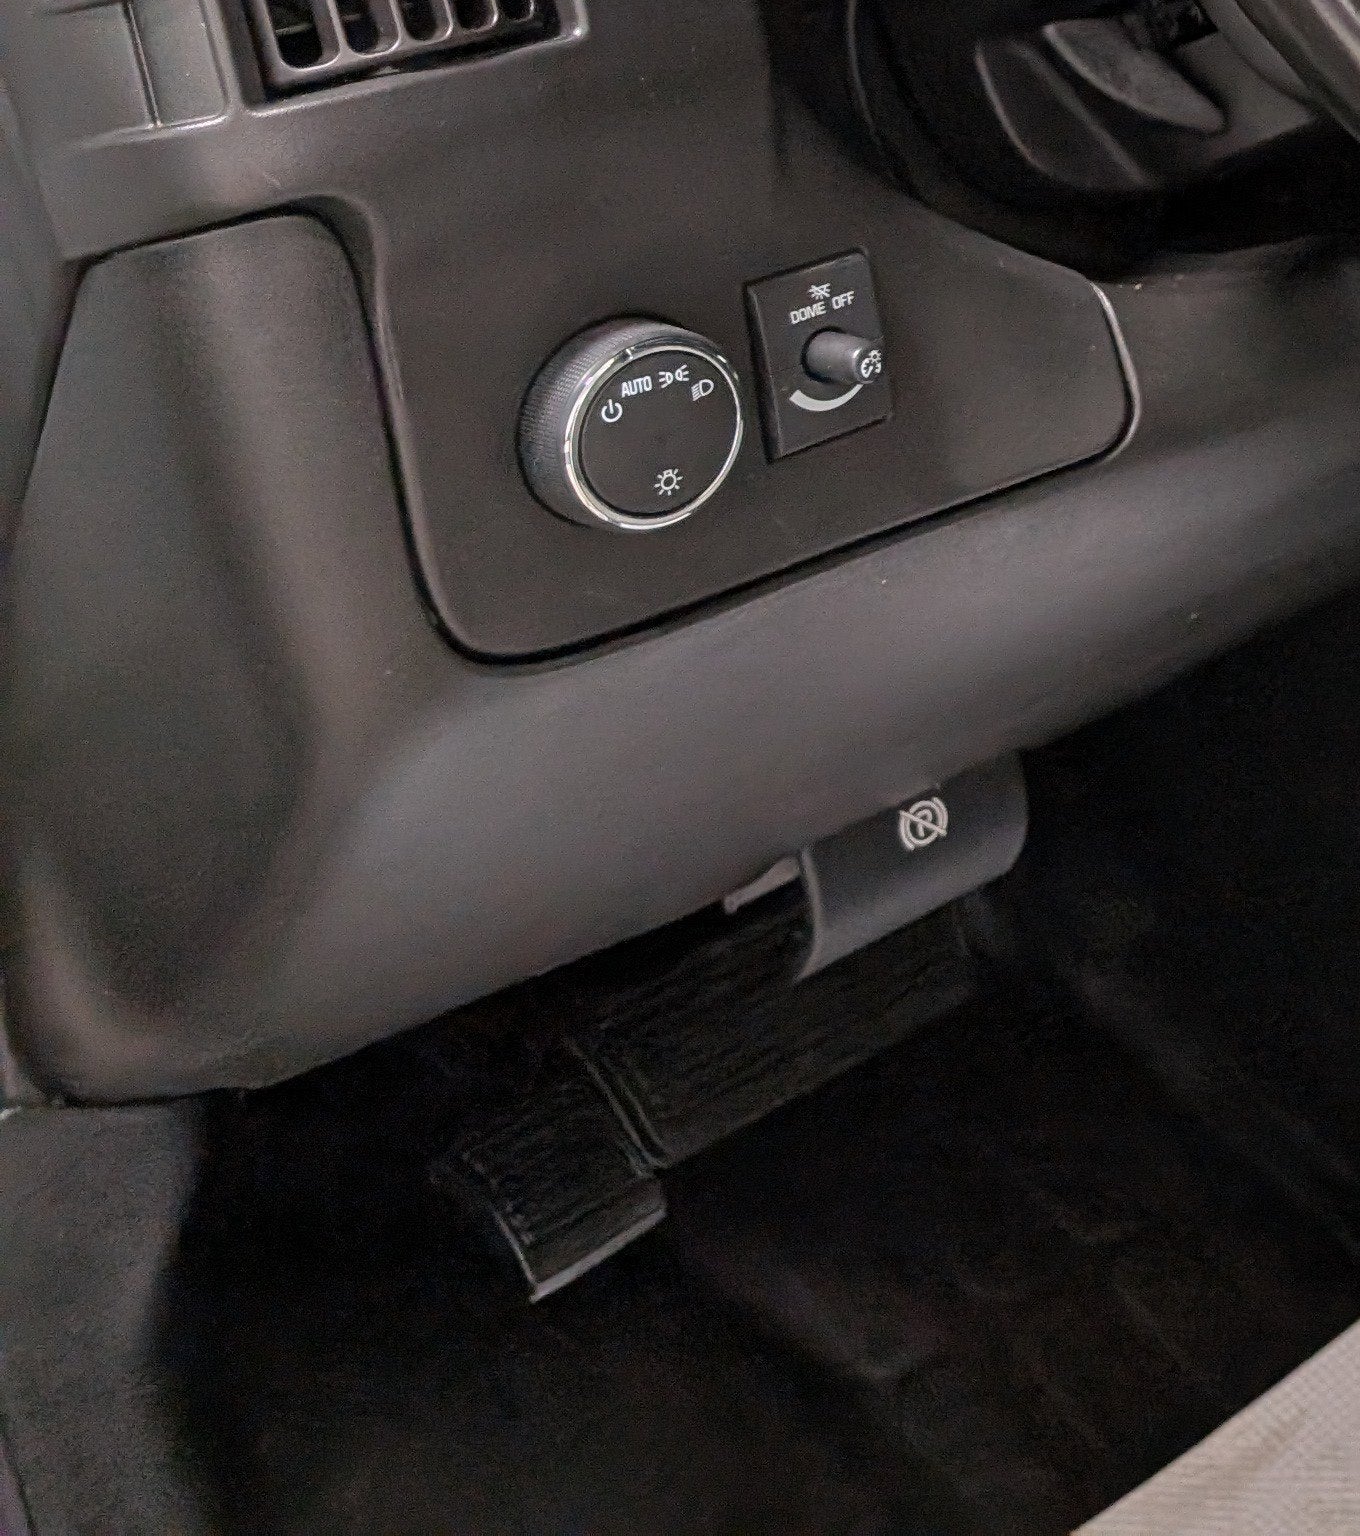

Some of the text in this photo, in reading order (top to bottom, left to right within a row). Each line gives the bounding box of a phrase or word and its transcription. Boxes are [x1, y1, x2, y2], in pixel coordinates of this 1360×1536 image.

[789, 291, 855, 325] DOME OFF
[620, 375, 653, 399] AUTO
